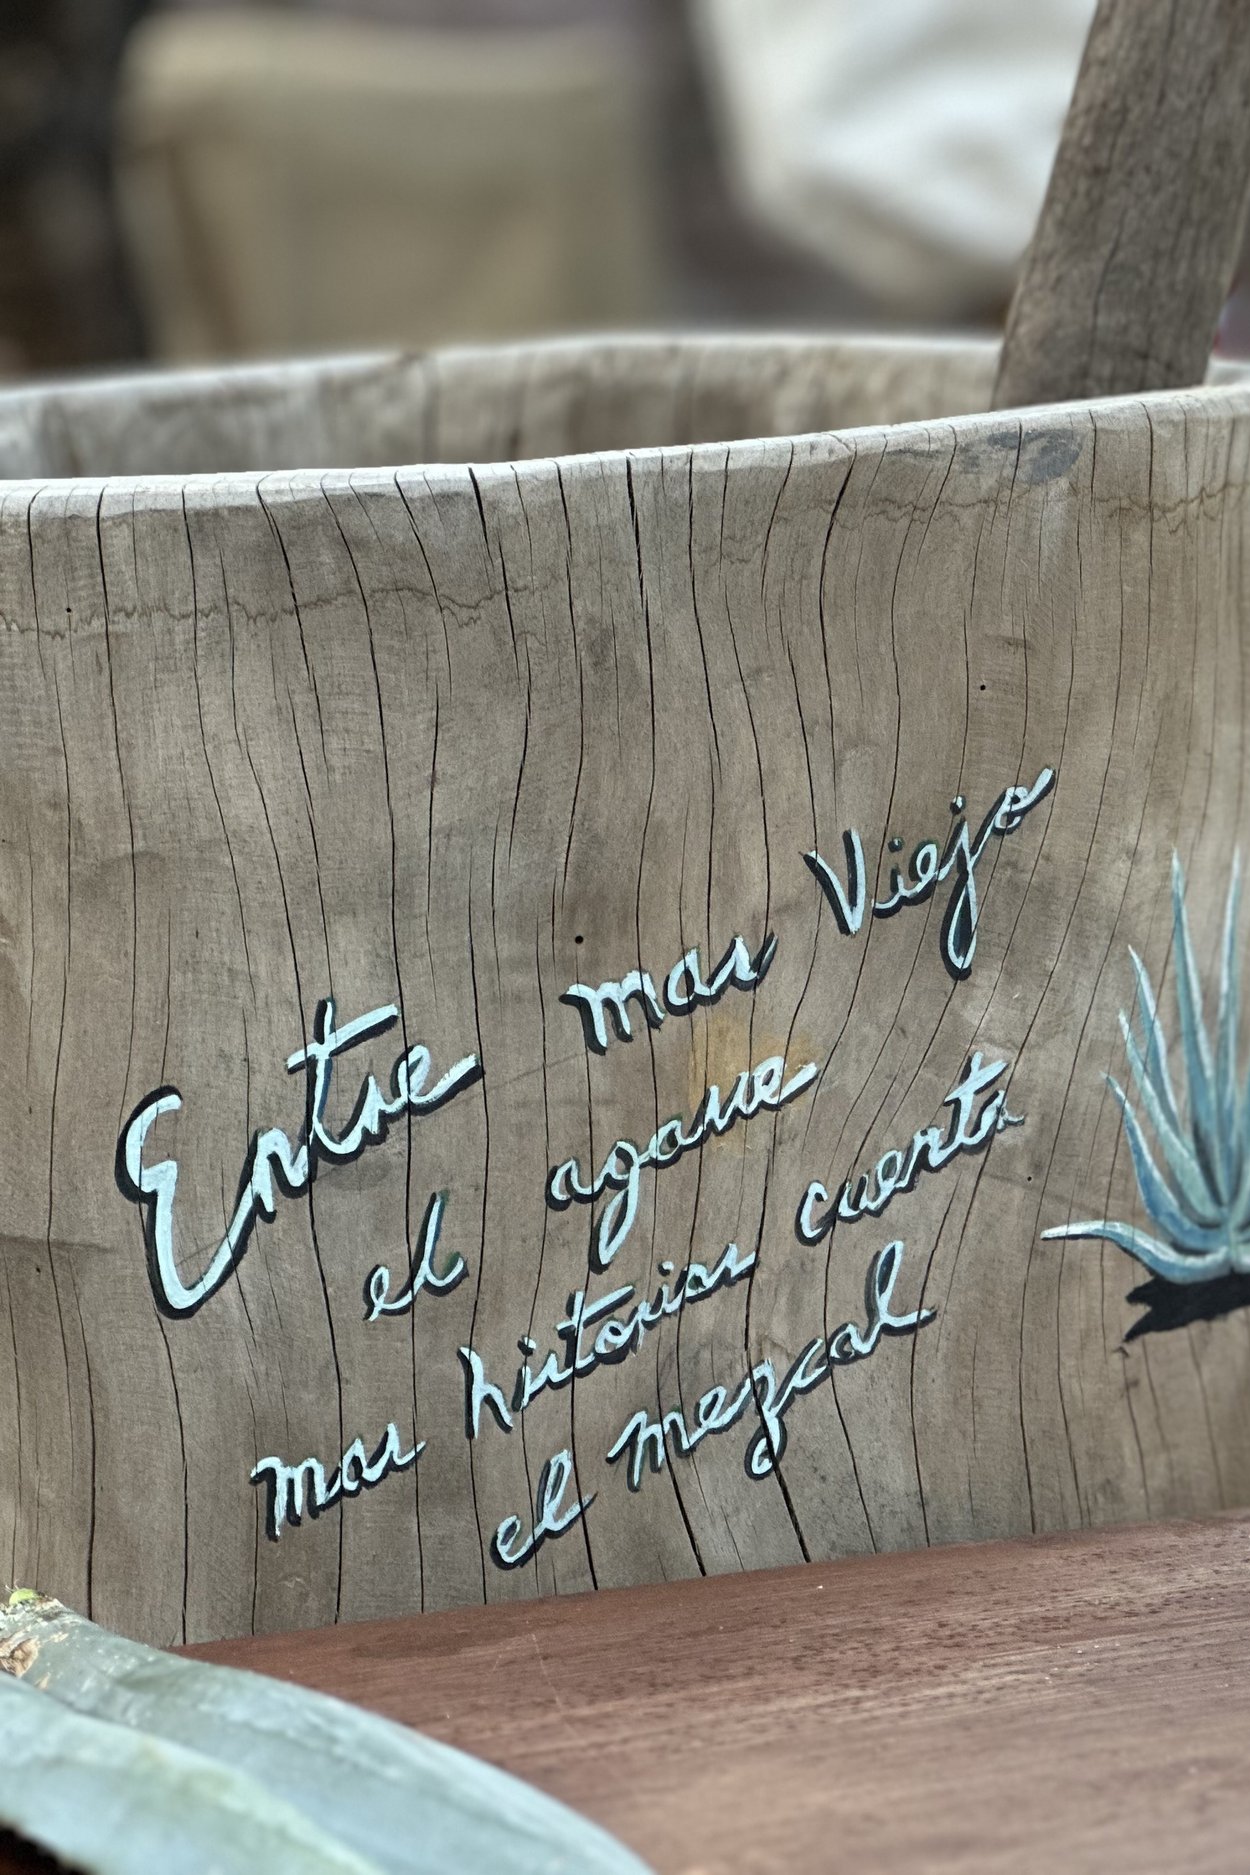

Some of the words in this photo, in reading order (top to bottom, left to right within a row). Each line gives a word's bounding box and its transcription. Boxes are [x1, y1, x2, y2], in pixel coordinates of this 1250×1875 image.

[115, 997, 484, 1318] Entre
[803, 765, 1055, 981] Viejo
[364, 1191, 469, 1321] el
[546, 1056, 818, 1274] agave
[459, 1243, 758, 1440] historias
[795, 1052, 1025, 1245] cuenta
[491, 1449, 598, 1570] el
[606, 1240, 936, 1490] mezcal
